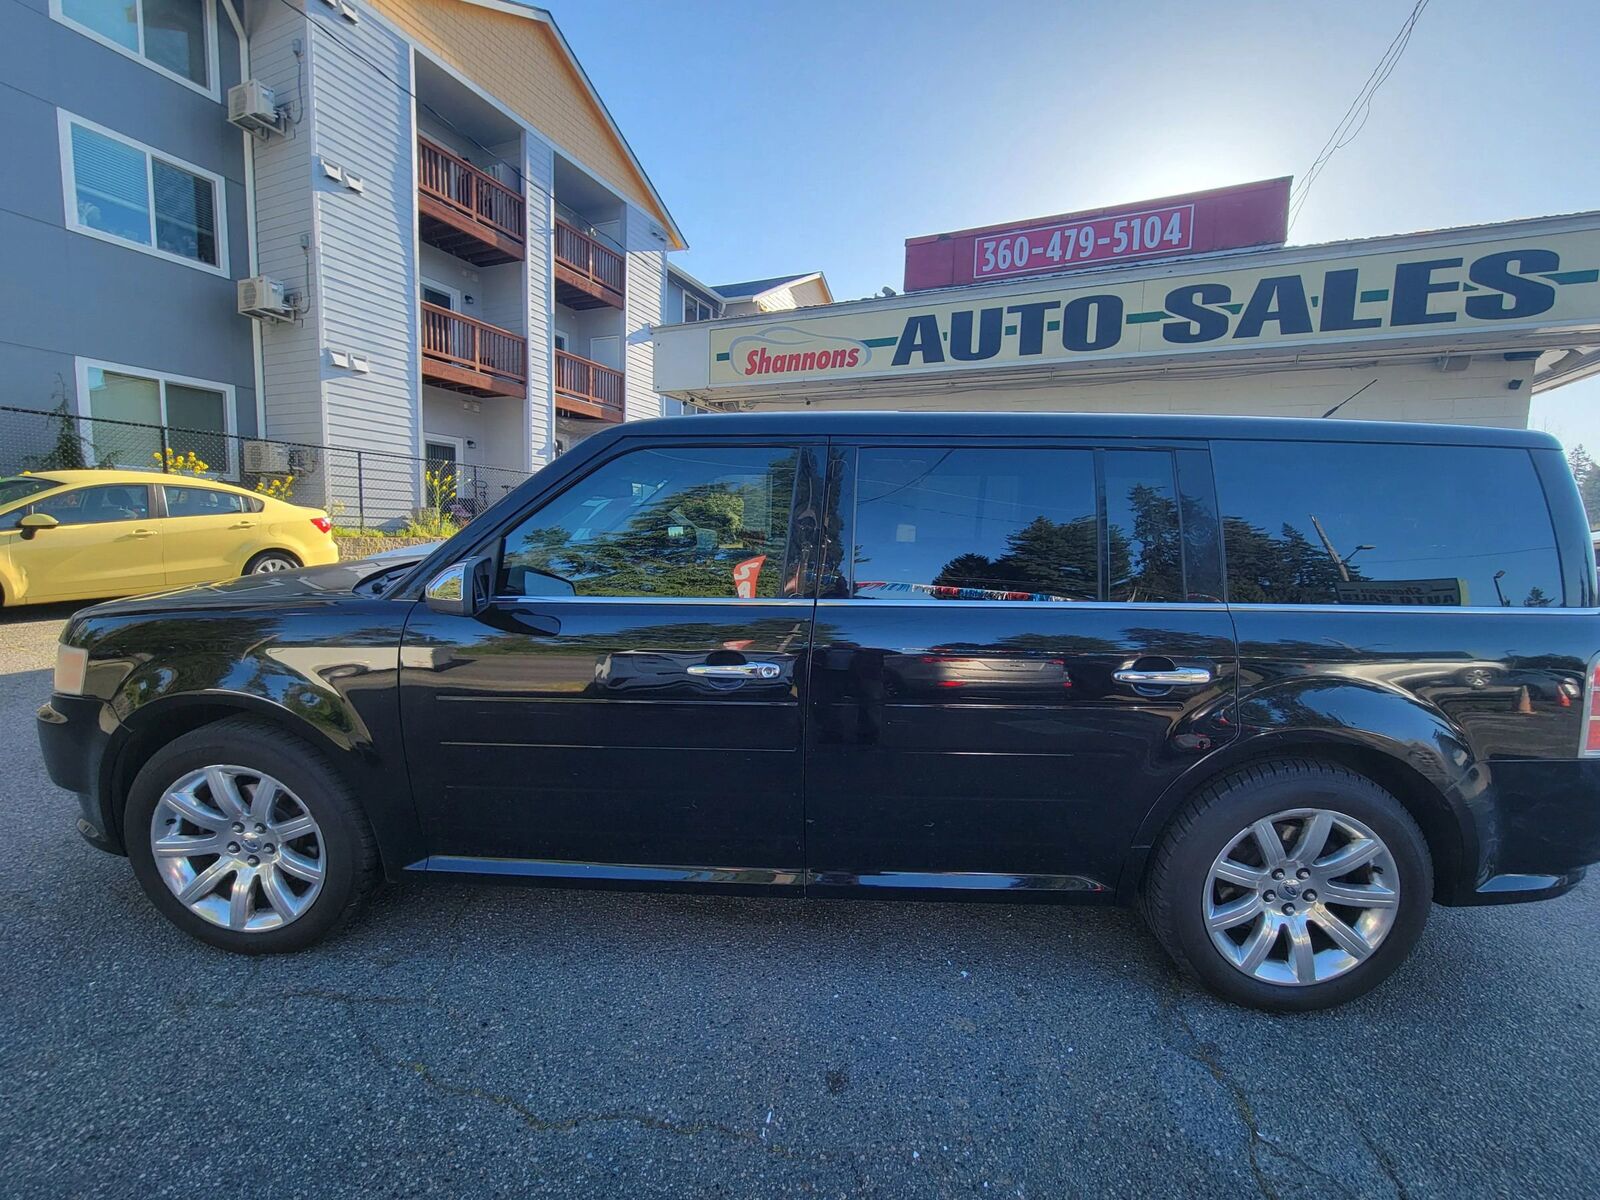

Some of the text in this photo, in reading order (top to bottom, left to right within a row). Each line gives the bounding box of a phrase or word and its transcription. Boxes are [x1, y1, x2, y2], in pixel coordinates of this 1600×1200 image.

[982, 212, 1182, 272] 360-479-5104
[891, 249, 1560, 366] AUTO SALES
[745, 347, 860, 376] Shannons
